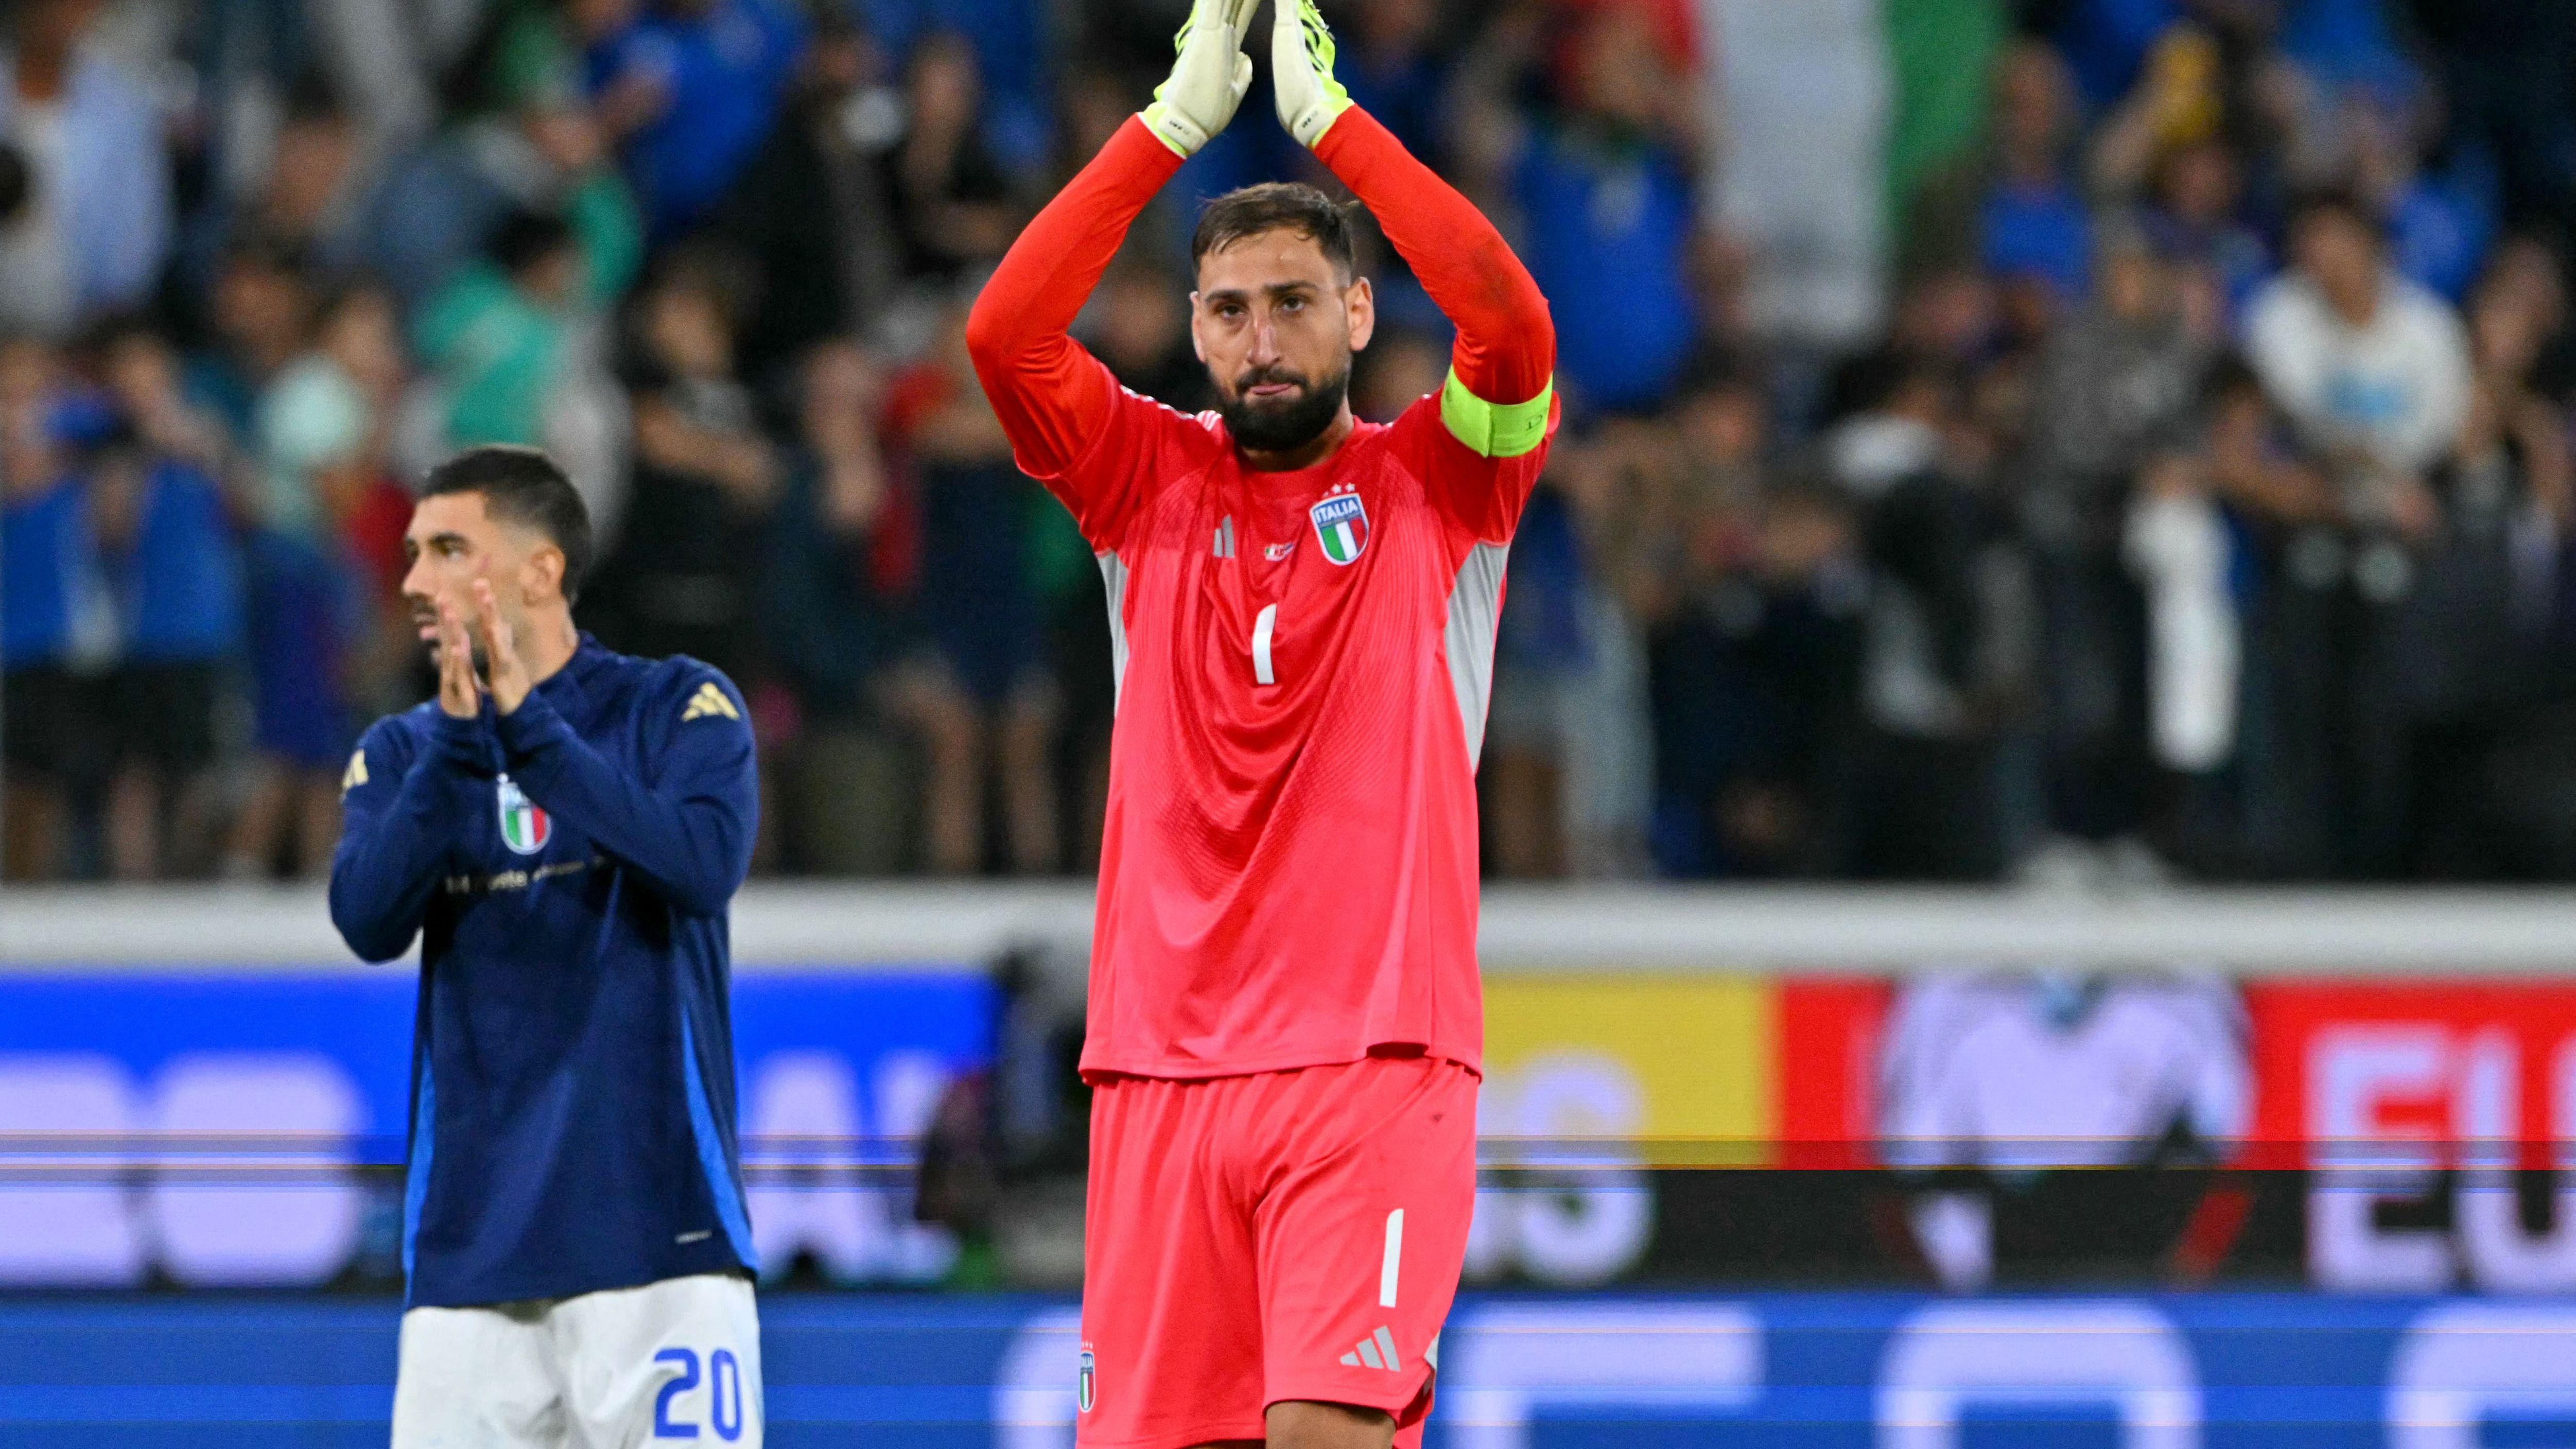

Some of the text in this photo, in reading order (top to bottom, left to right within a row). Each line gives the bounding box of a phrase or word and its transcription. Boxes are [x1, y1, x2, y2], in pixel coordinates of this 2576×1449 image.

[1314, 499, 1359, 523] ITALIA
[1252, 603, 1277, 684] 1
[1379, 1208, 1404, 1308] 1
[654, 1348, 742, 1441] 20
